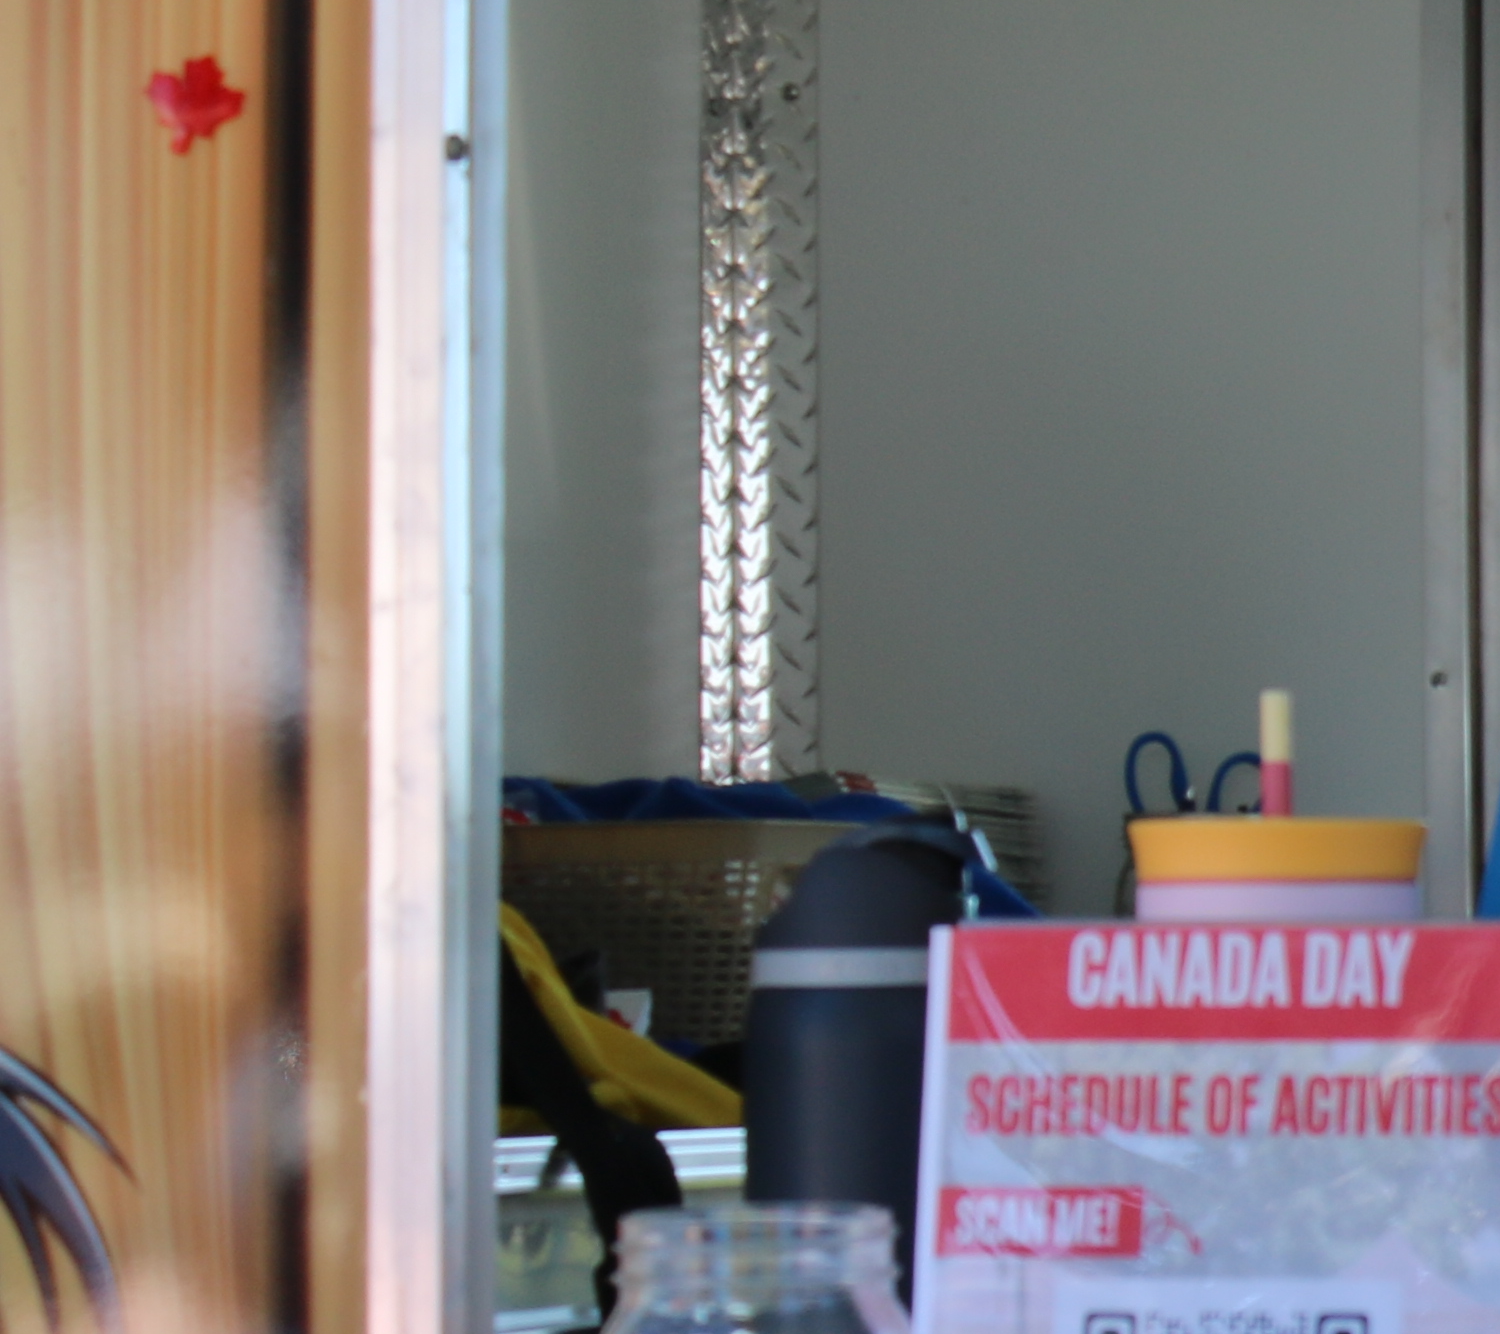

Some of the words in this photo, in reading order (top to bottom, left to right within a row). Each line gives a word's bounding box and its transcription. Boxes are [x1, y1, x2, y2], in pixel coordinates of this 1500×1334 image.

[1067, 930, 1292, 1010] CANADA
[1302, 930, 1415, 1009] DAY
[966, 1075, 1191, 1136] SCHEDULE
[1206, 1075, 1262, 1136] OF
[954, 1194, 1046, 1248] SCAN
[1053, 1194, 1119, 1248] ME!
